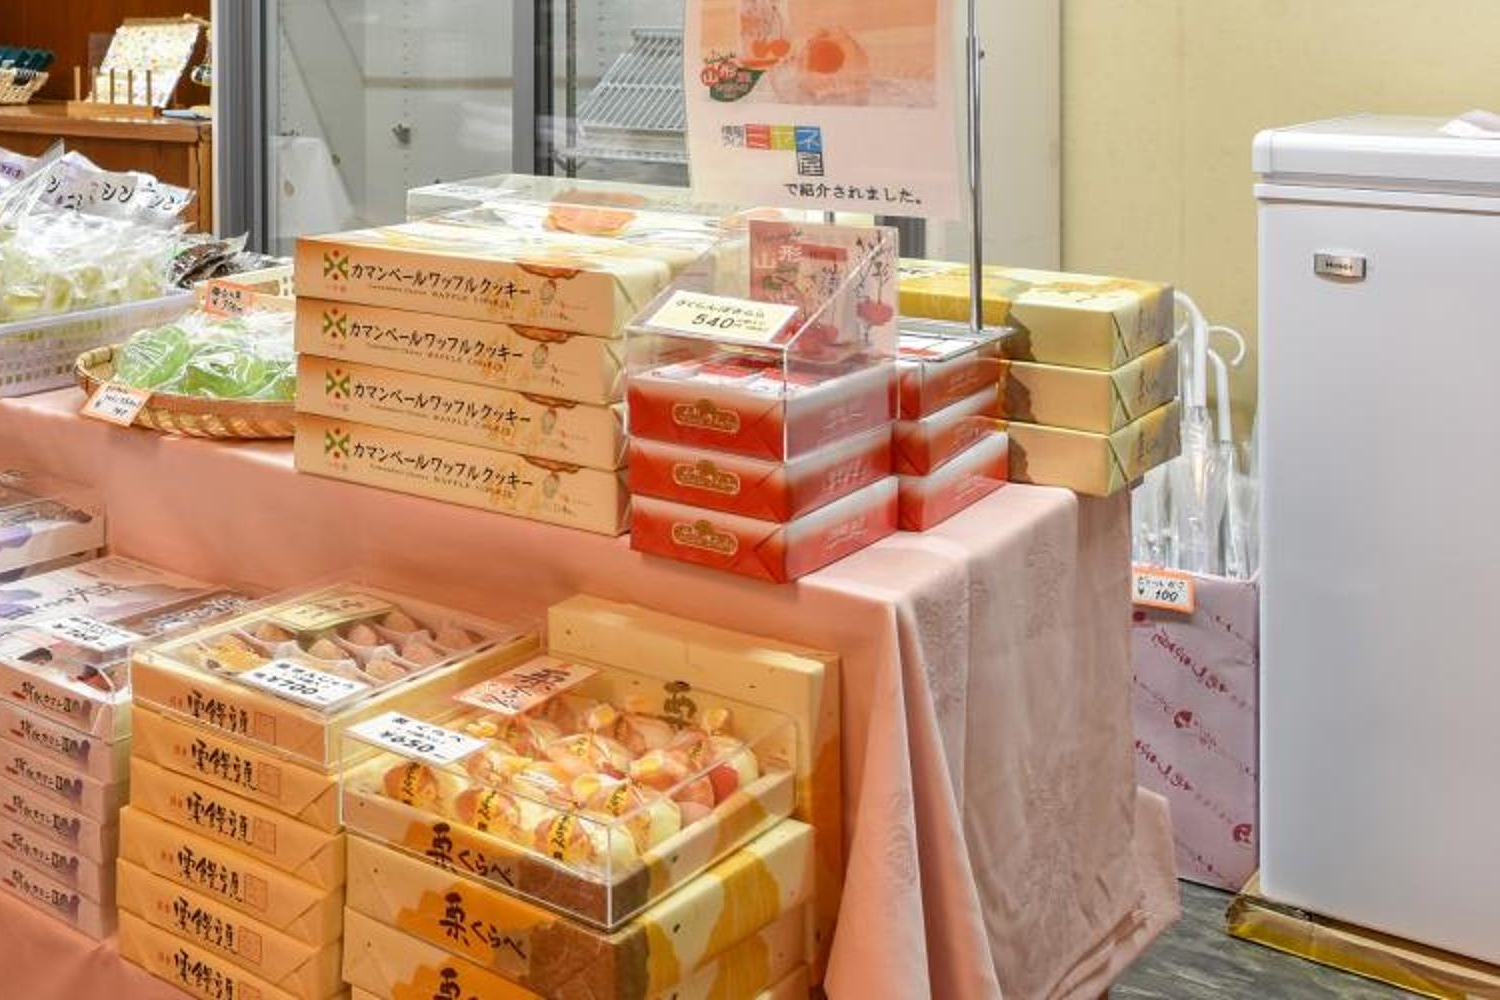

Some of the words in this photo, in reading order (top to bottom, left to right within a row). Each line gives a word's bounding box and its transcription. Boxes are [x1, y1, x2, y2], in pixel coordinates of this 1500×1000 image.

[784, 183, 921, 204] で紹介されました。
[351, 263, 531, 296] カマンベールワッフルクッキー
[350, 322, 524, 359] カマンベールワッフルクッキー
[354, 383, 531, 424] カマンベールワッフルクッキー
[353, 442, 533, 487] カマンベールワッフルクッキー
[426, 822, 515, 887] 栗くらべ
[439, 892, 527, 960] 栗くらべ
